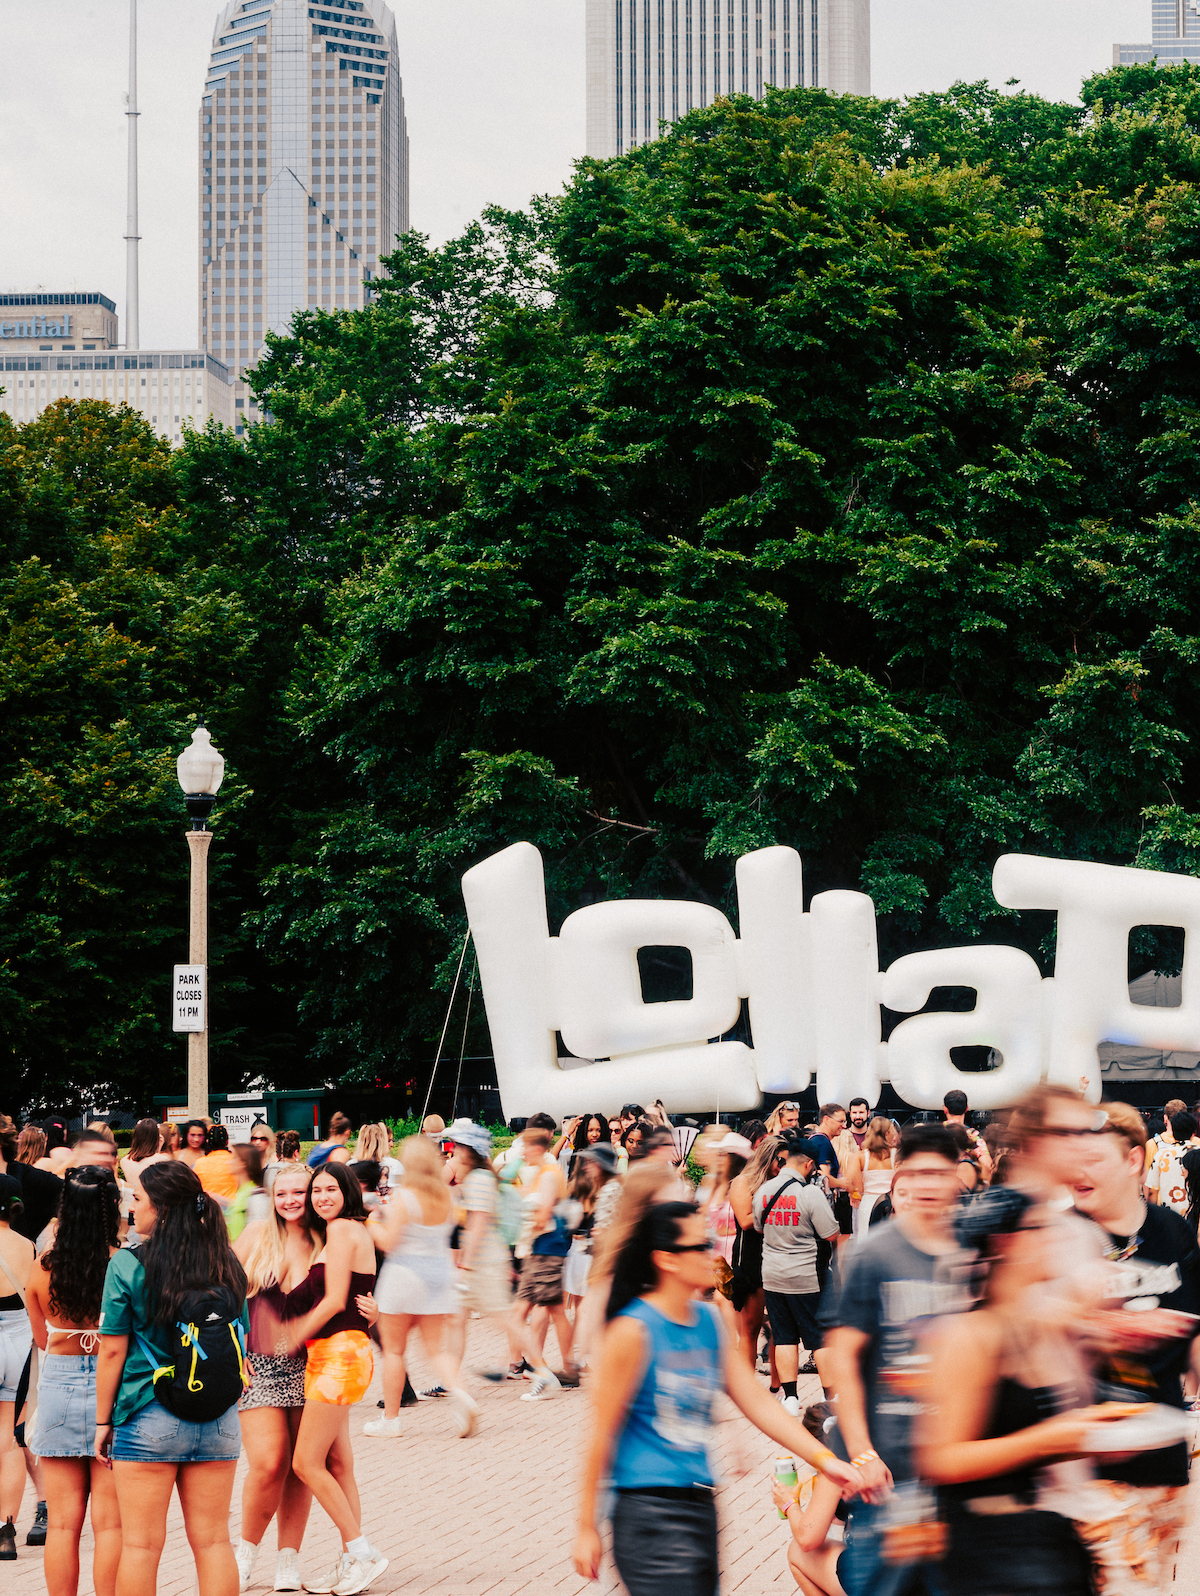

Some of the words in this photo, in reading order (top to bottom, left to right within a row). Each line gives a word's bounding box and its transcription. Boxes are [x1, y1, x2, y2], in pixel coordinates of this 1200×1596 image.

[179, 975, 200, 985] PARK
[176, 990, 202, 1001] CLOSES
[179, 1007, 186, 1017] 11
[187, 1007, 199, 1017] PM
[225, 1115, 250, 1124] TRASH
[762, 1211, 800, 1226] TAFF
